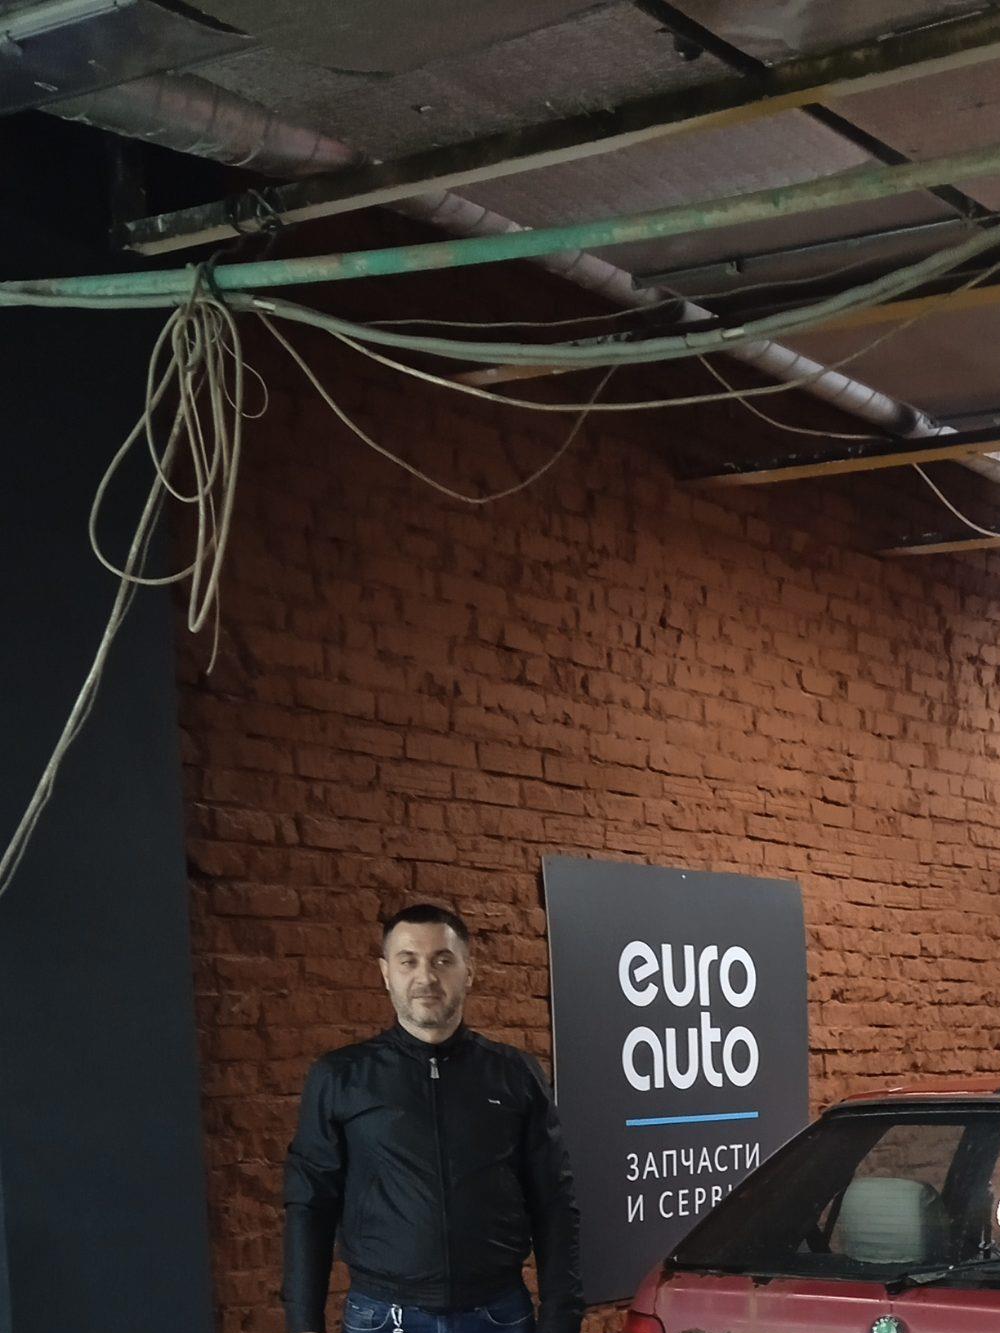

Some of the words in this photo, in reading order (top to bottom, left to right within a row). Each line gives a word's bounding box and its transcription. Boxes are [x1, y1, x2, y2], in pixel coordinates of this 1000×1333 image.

[618, 940, 757, 1008] euro
[622, 1012, 759, 1091] auto
[626, 1143, 760, 1181] ЗАПЧАСТИ
[627, 1194, 644, 1223] И
[659, 1184, 733, 1218] СЕРВ
